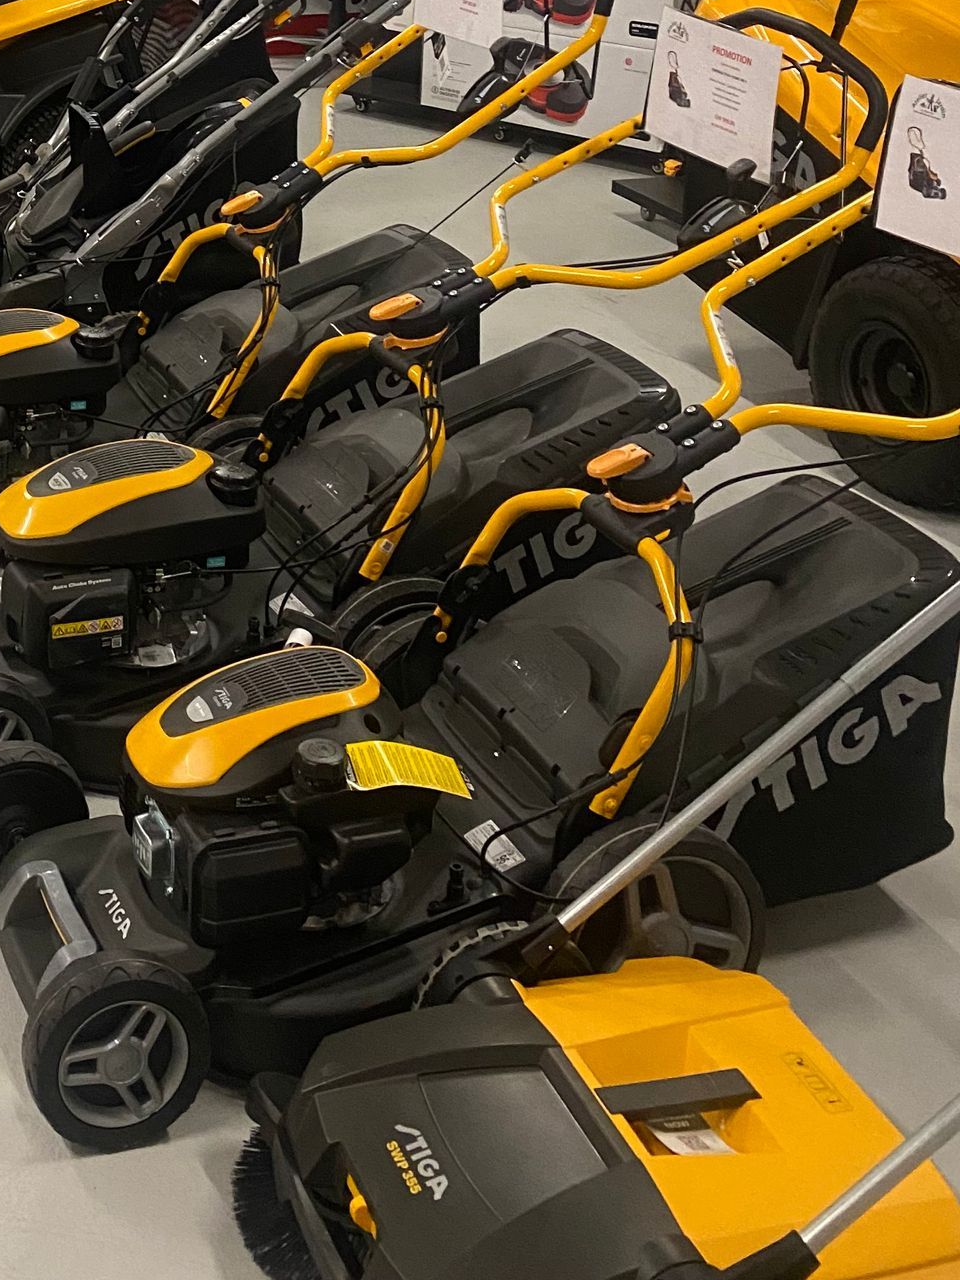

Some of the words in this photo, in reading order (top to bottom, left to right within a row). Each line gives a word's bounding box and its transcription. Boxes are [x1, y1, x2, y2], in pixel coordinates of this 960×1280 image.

[711, 45, 753, 66] PROMOTION
[493, 511, 597, 594] TIG
[214, 689, 233, 710] STIGA
[714, 673, 942, 842] STIGA
[98, 888, 131, 940] STIGA
[386, 1140, 409, 1169] SWP
[402, 1170, 422, 1195] 355
[393, 1124, 449, 1201] STIGA
